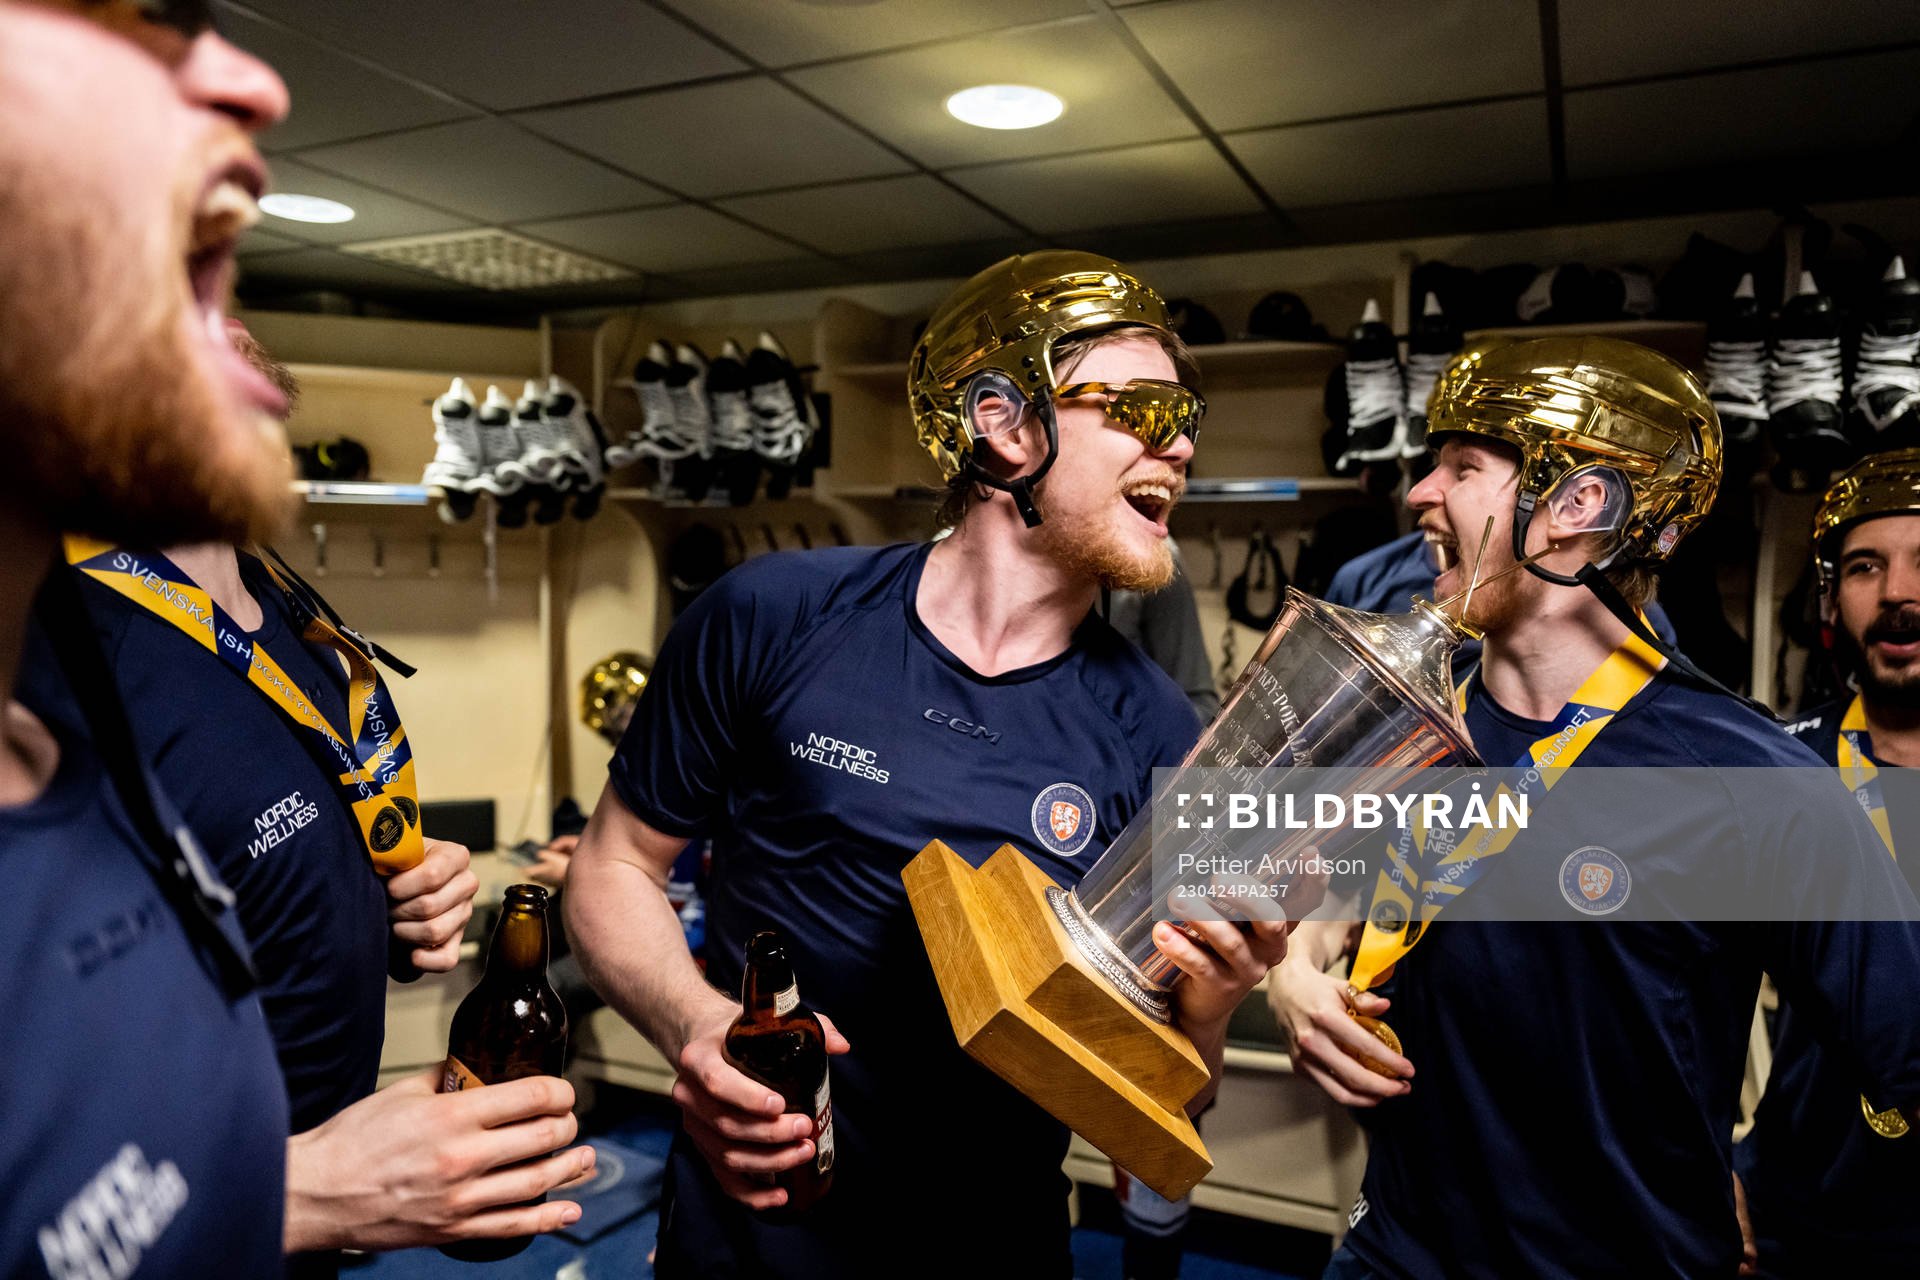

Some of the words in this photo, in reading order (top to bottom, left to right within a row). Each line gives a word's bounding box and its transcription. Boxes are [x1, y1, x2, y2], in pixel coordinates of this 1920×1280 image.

[112, 552, 215, 632] SVENSKA
[364, 690, 399, 785] SVENSKA
[922, 707, 1002, 745] CCM
[790, 742, 890, 784] WELLNESS
[808, 732, 877, 764] NORDIC
[248, 801, 319, 859] WELLNESS
[254, 791, 304, 834] NORDIC
